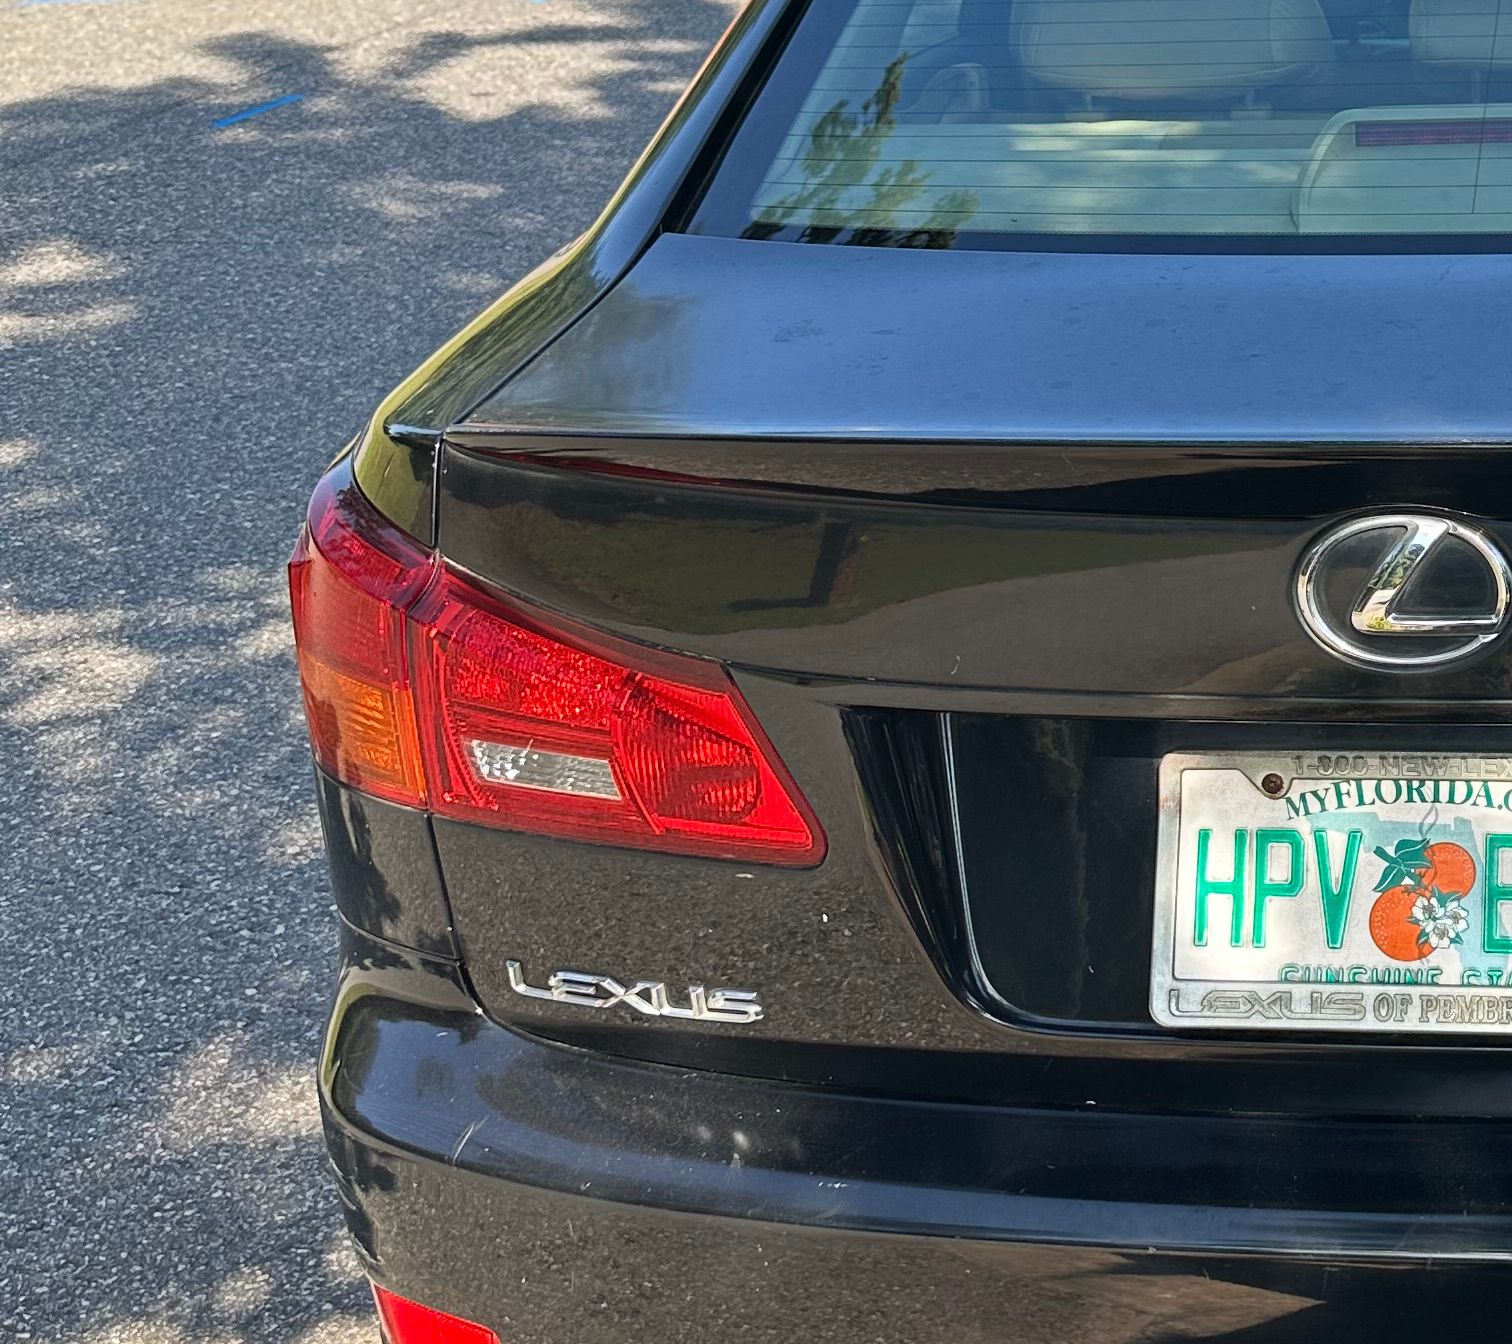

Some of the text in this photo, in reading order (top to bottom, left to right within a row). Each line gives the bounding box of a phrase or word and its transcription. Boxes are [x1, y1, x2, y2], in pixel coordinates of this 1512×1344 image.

[1194, 828, 1363, 950] HPV
[505, 959, 765, 1023] LEXUS
[1168, 988, 1367, 1022] LEXUS
[1373, 992, 1413, 1023] OF
